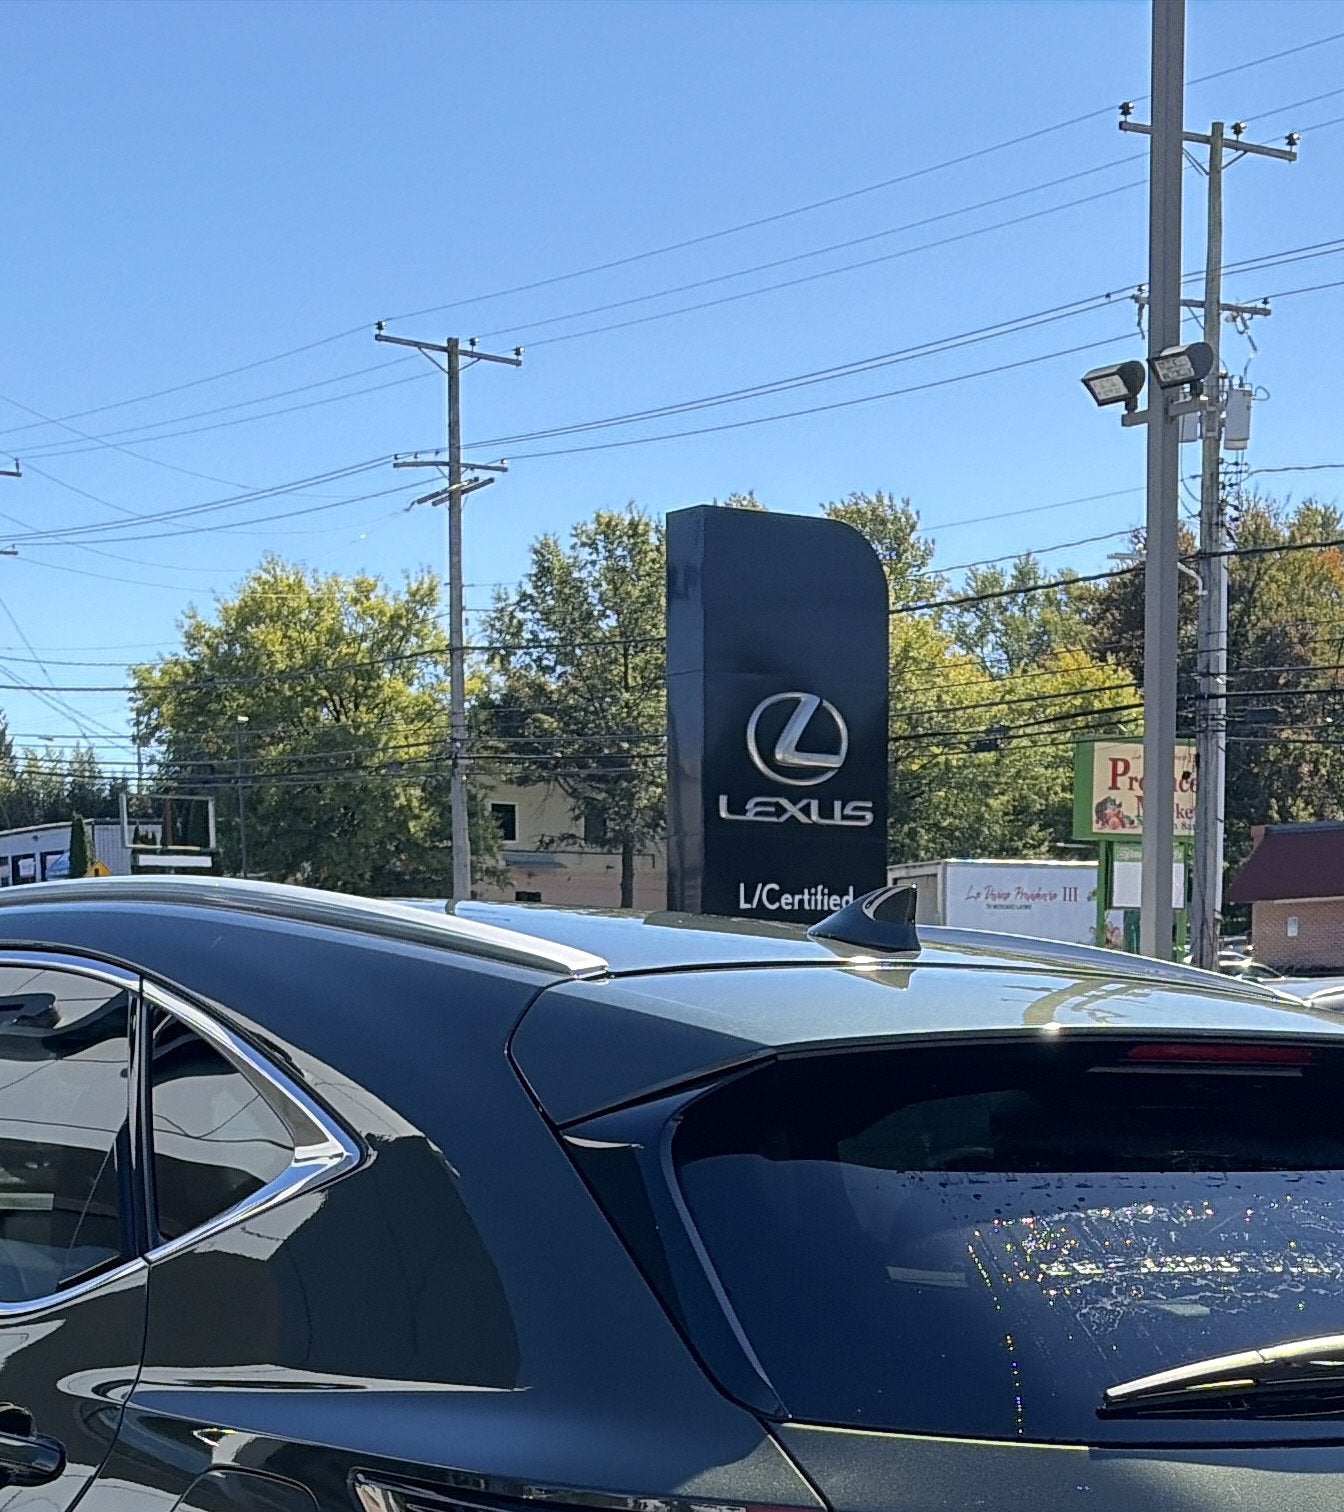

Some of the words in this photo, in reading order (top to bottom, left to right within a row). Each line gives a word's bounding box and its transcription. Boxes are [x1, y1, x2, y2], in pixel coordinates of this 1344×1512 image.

[718, 794, 875, 827] LEXUS
[739, 882, 854, 911] L/Certified
[1062, 886, 1079, 902] III
